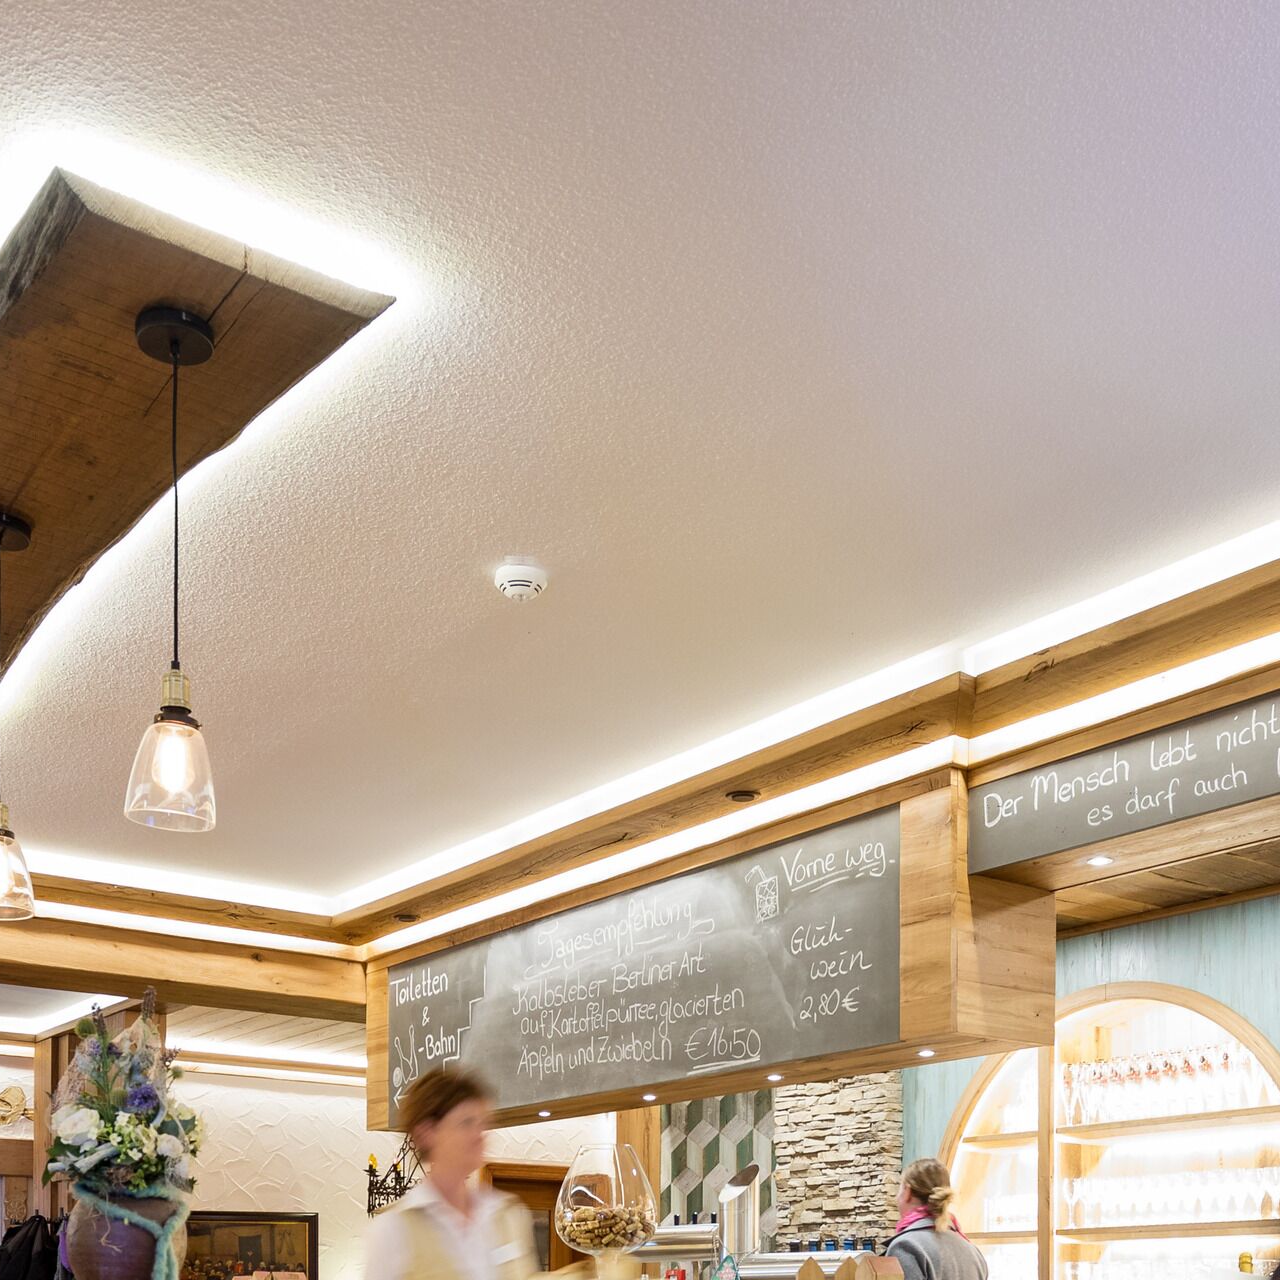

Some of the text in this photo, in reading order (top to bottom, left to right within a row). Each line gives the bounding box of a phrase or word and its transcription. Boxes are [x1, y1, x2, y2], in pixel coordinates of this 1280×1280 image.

[983, 792, 1023, 828] Der
[1031, 752, 1129, 811] Mensch
[1150, 730, 1197, 771] lebt
[1216, 704, 1280, 752] nicht
[1087, 803, 1113, 826] es
[1125, 778, 1180, 814] darf
[1194, 762, 1247, 797] auch
[780, 848, 836, 886] Vorne
[537, 898, 693, 969] Tagesempfehlung
[389, 967, 449, 1007] Toiletten
[512, 942, 706, 1015] Kalbsleber Berliner Art
[810, 950, 872, 980] wein
[421, 1006, 431, 1026] &
[520, 1010, 547, 1036] auf
[517, 1045, 564, 1081] Äpfeln
[568, 1037, 594, 1070] und
[597, 1028, 672, 1065] Zwiebeln
